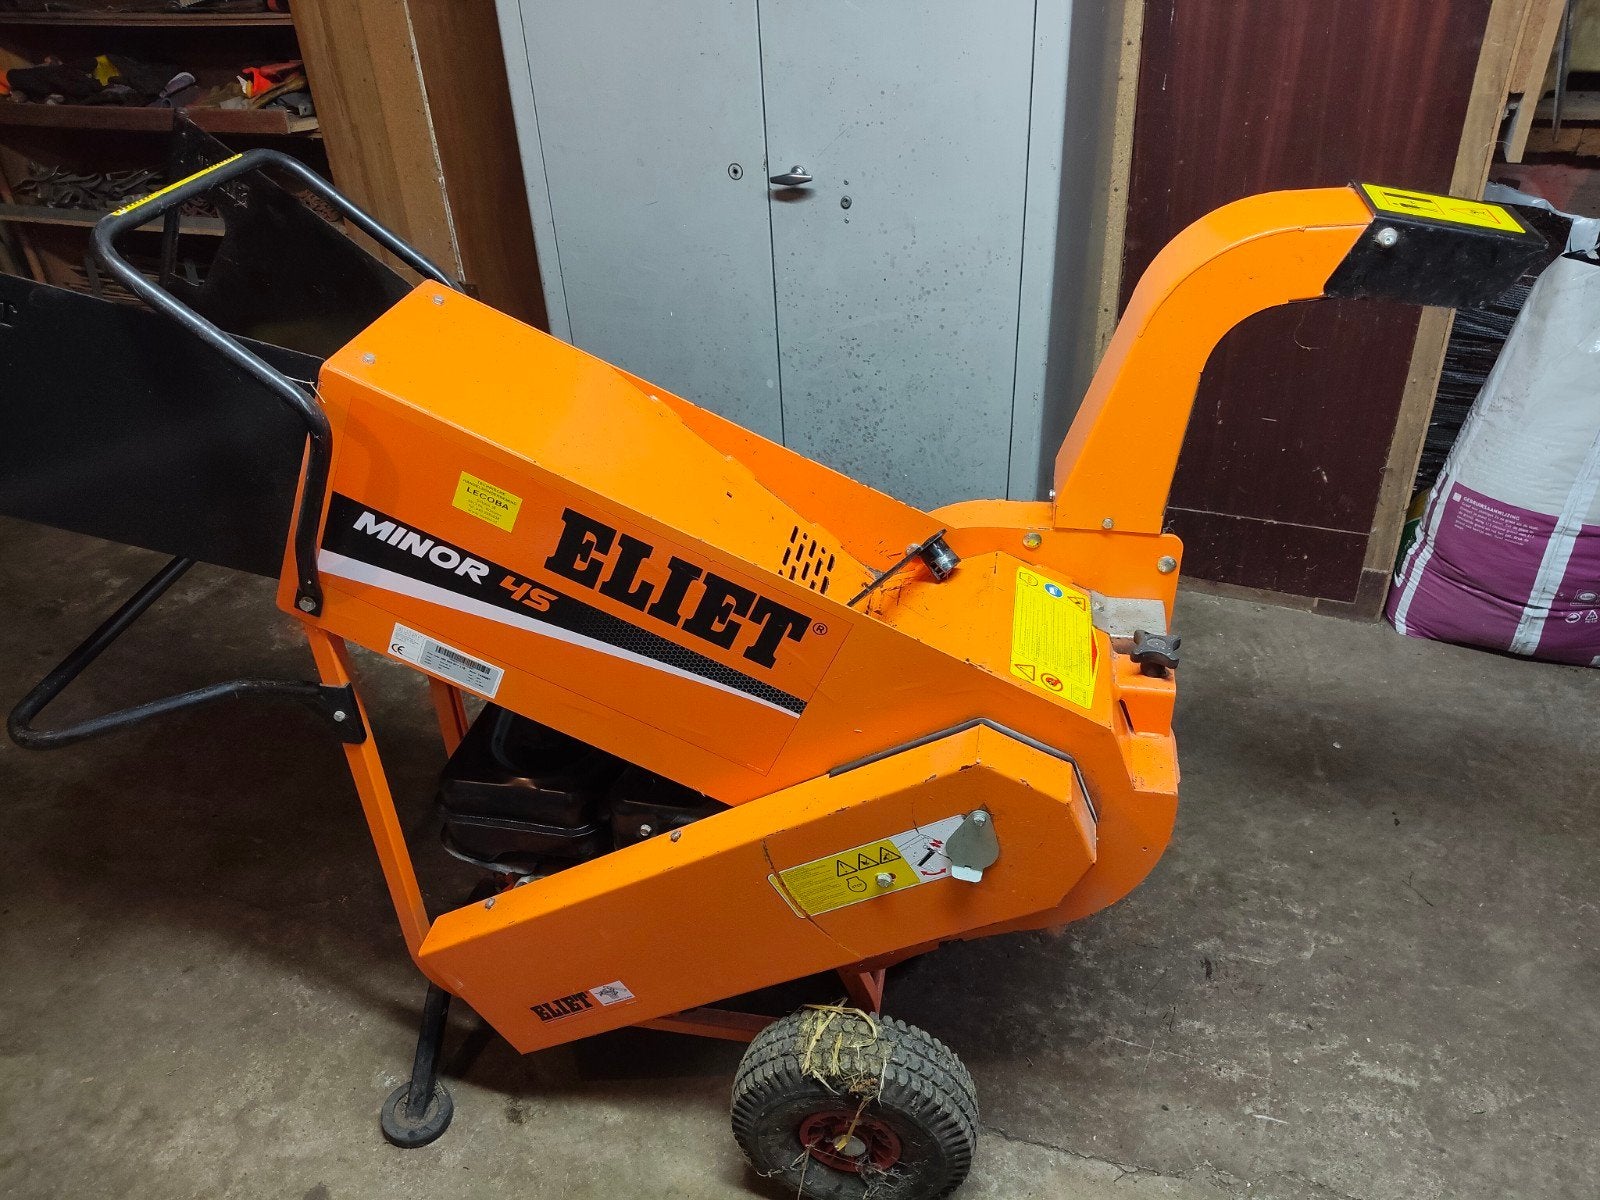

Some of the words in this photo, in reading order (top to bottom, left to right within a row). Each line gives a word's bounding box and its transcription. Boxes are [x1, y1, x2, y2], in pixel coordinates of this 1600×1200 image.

[466, 487, 509, 511] LECOBA
[353, 511, 490, 585] MINOR
[499, 576, 560, 612] 45
[530, 991, 594, 1022] ELIET
